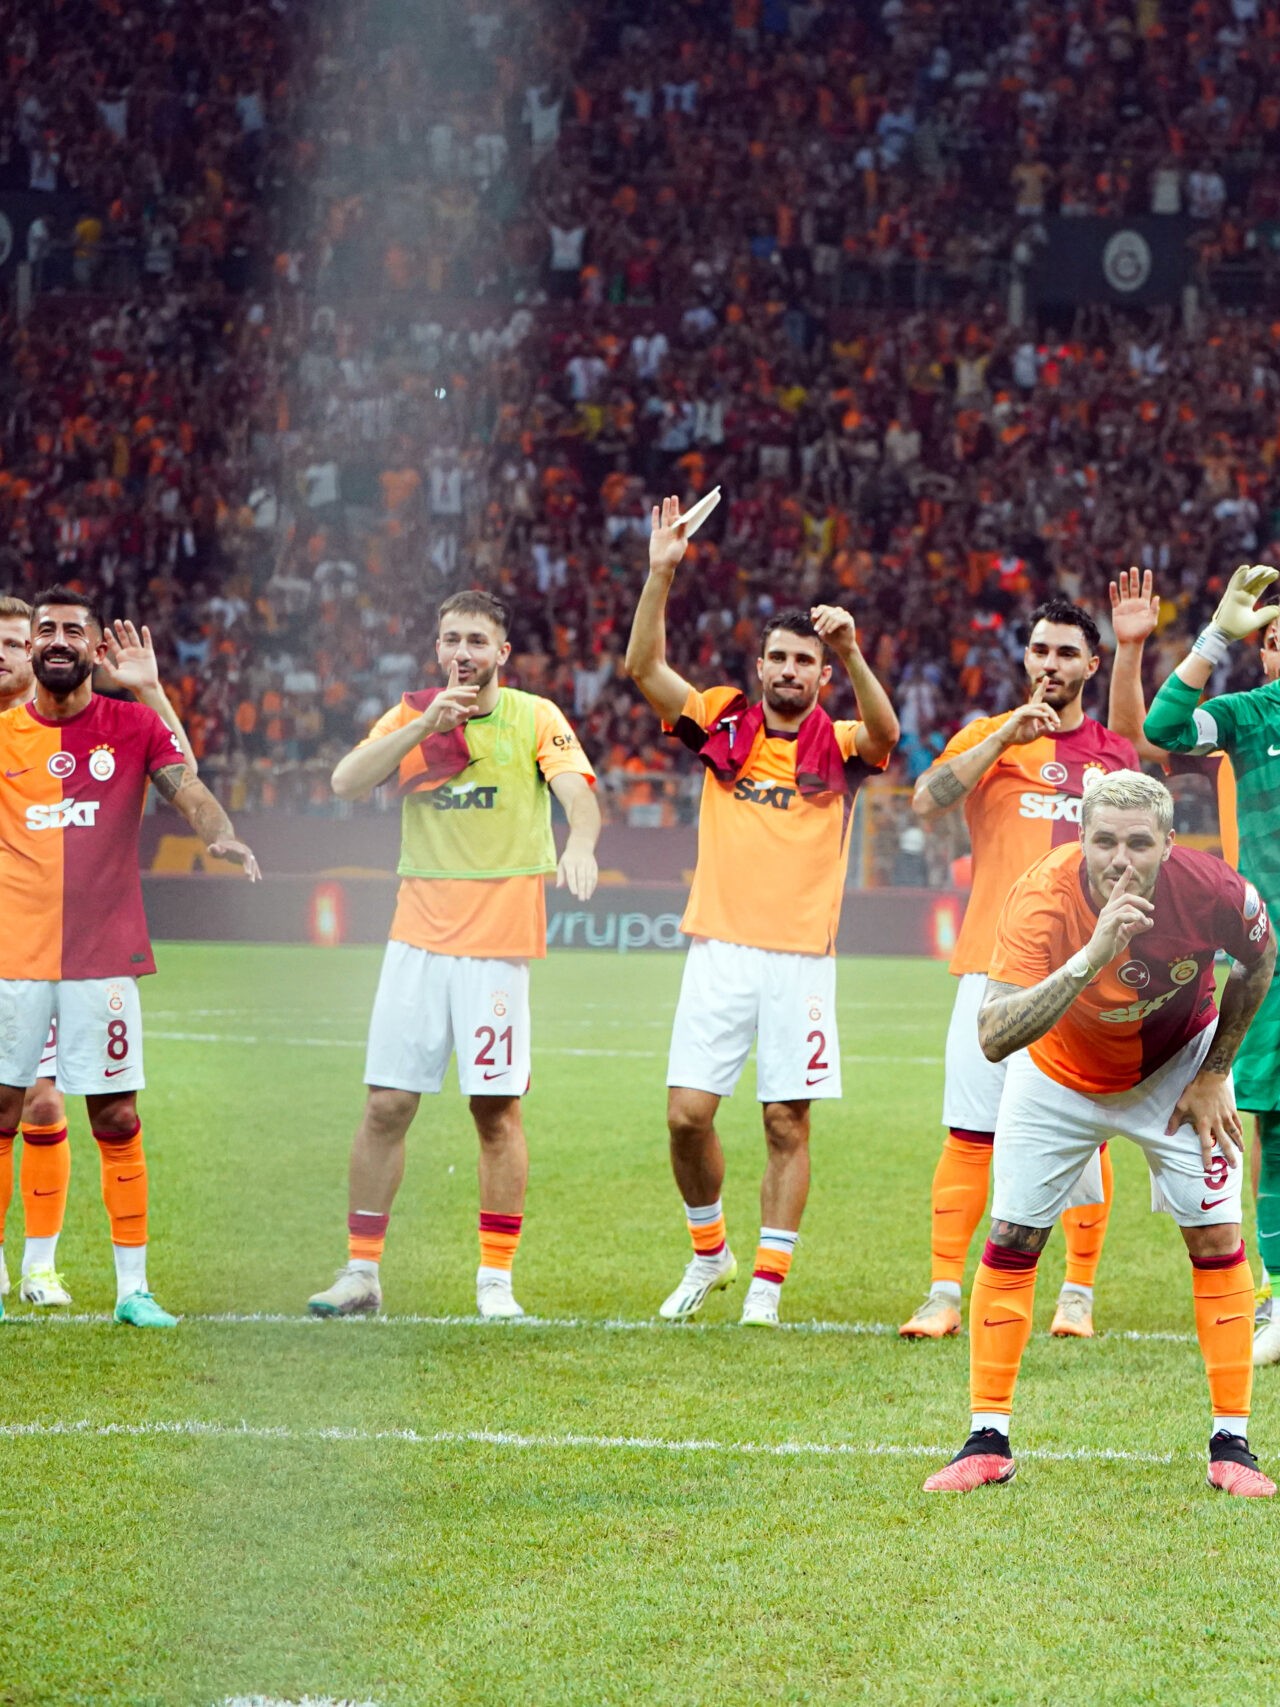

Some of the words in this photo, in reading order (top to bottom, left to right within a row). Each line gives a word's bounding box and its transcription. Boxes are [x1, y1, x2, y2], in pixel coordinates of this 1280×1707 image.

[734, 777, 796, 810] SIXT
[25, 798, 100, 831] SIXT
[107, 1019, 129, 1061] 8
[474, 1025, 513, 1066] 21
[806, 1030, 829, 1070] 2
[1203, 1155, 1229, 1191] 9
